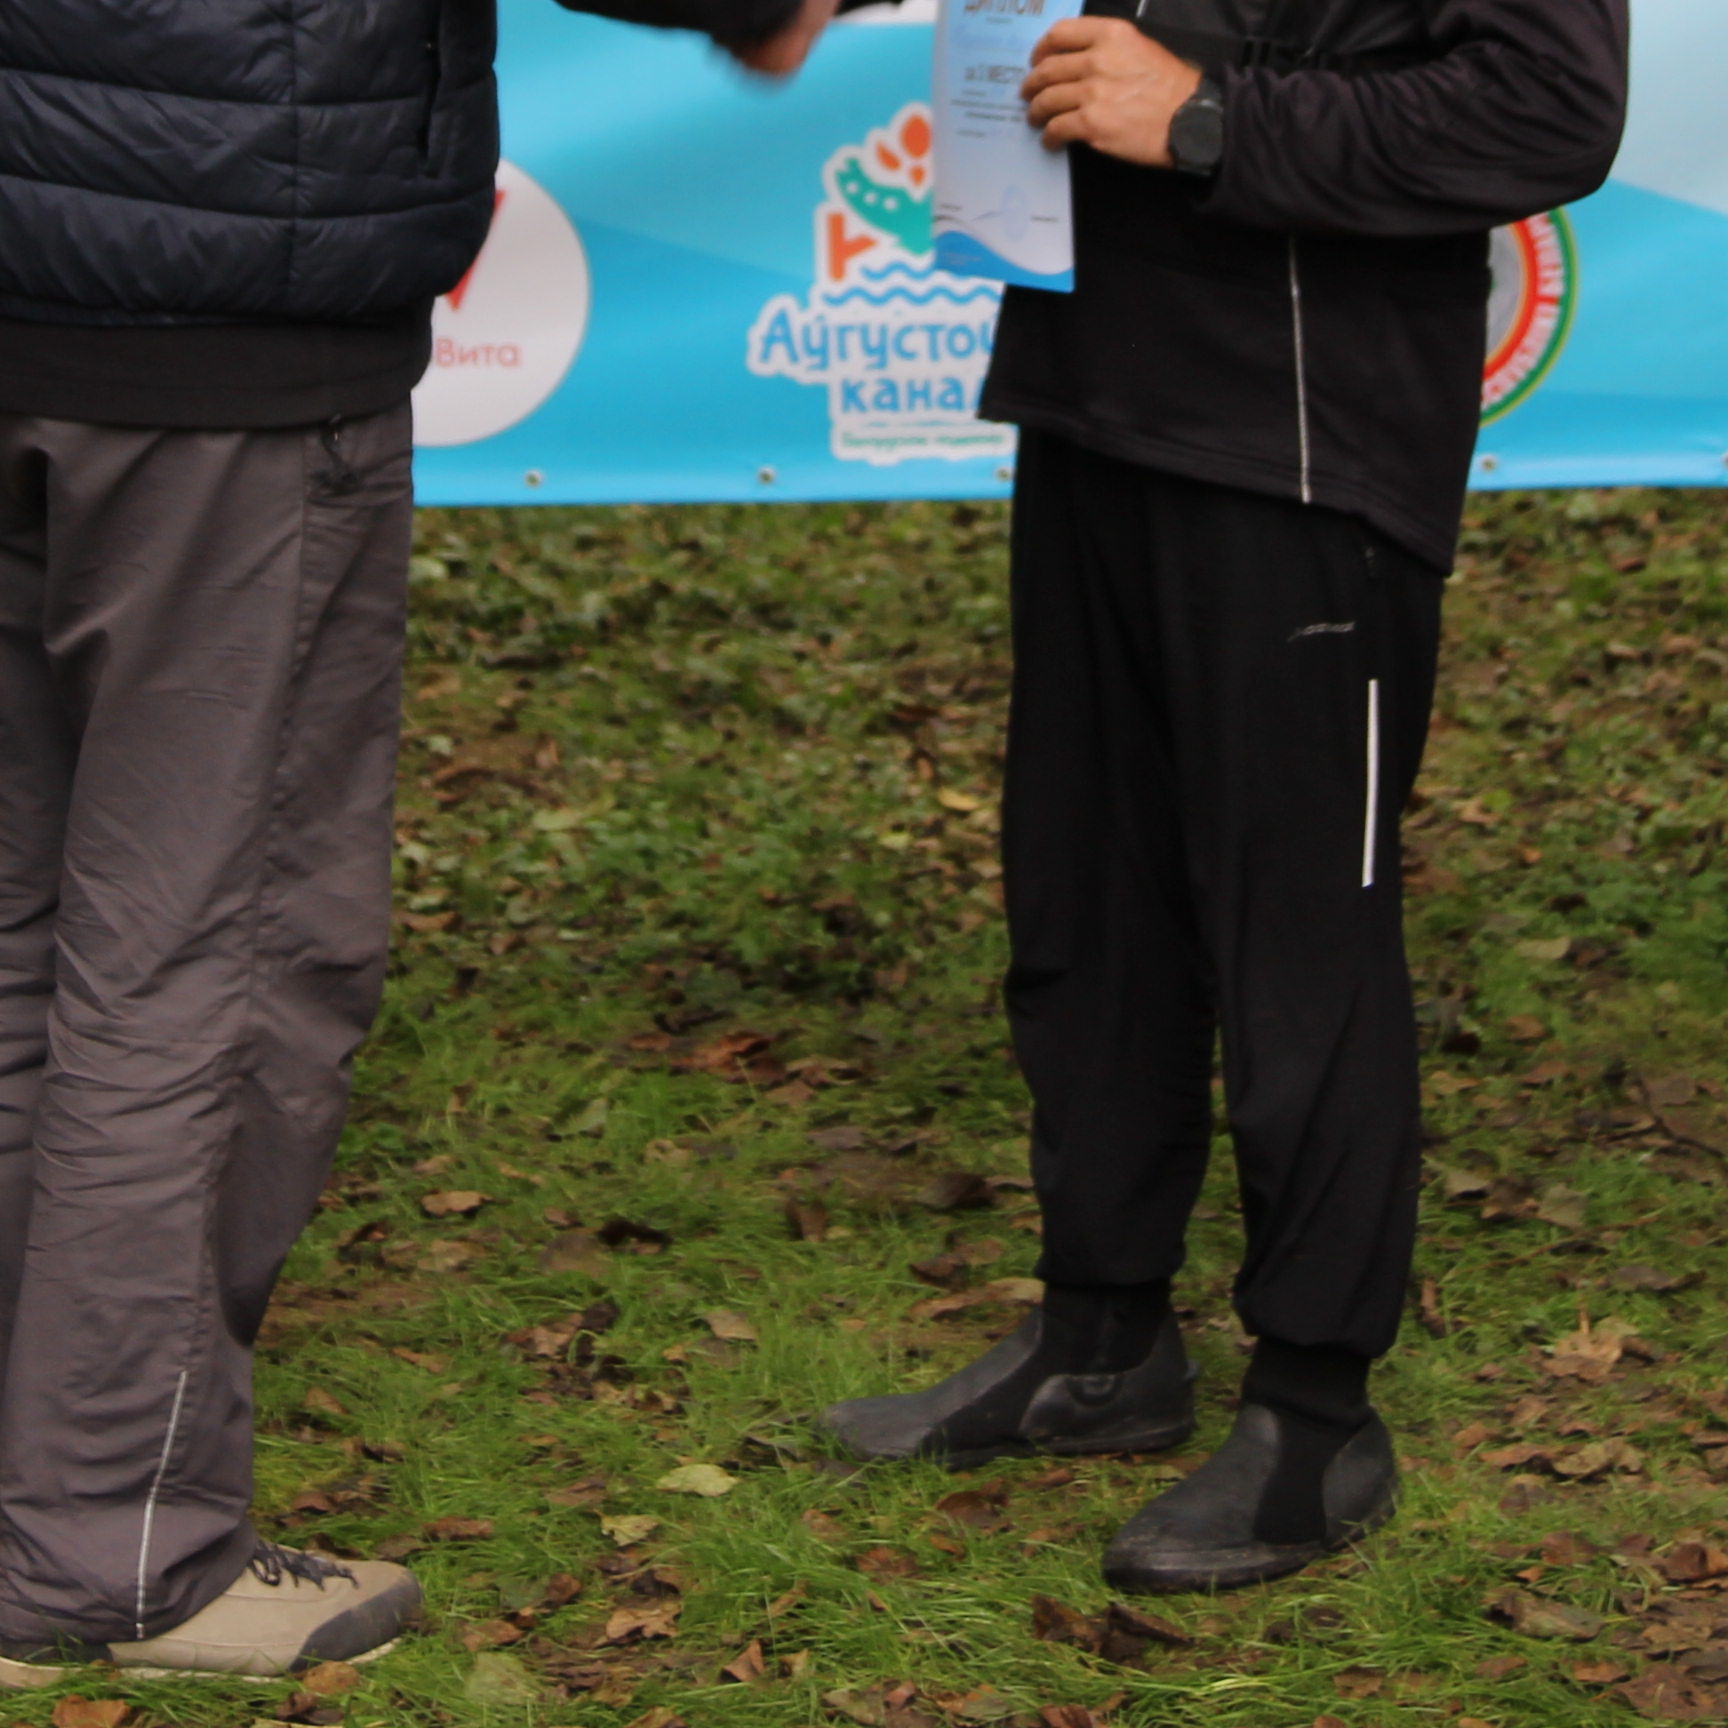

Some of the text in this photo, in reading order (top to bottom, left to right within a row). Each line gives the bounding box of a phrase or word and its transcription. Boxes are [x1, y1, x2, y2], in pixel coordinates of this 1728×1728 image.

[435, 337, 521, 368] Вита
[759, 308, 996, 370] Аўгусто
[841, 377, 984, 413] кана
